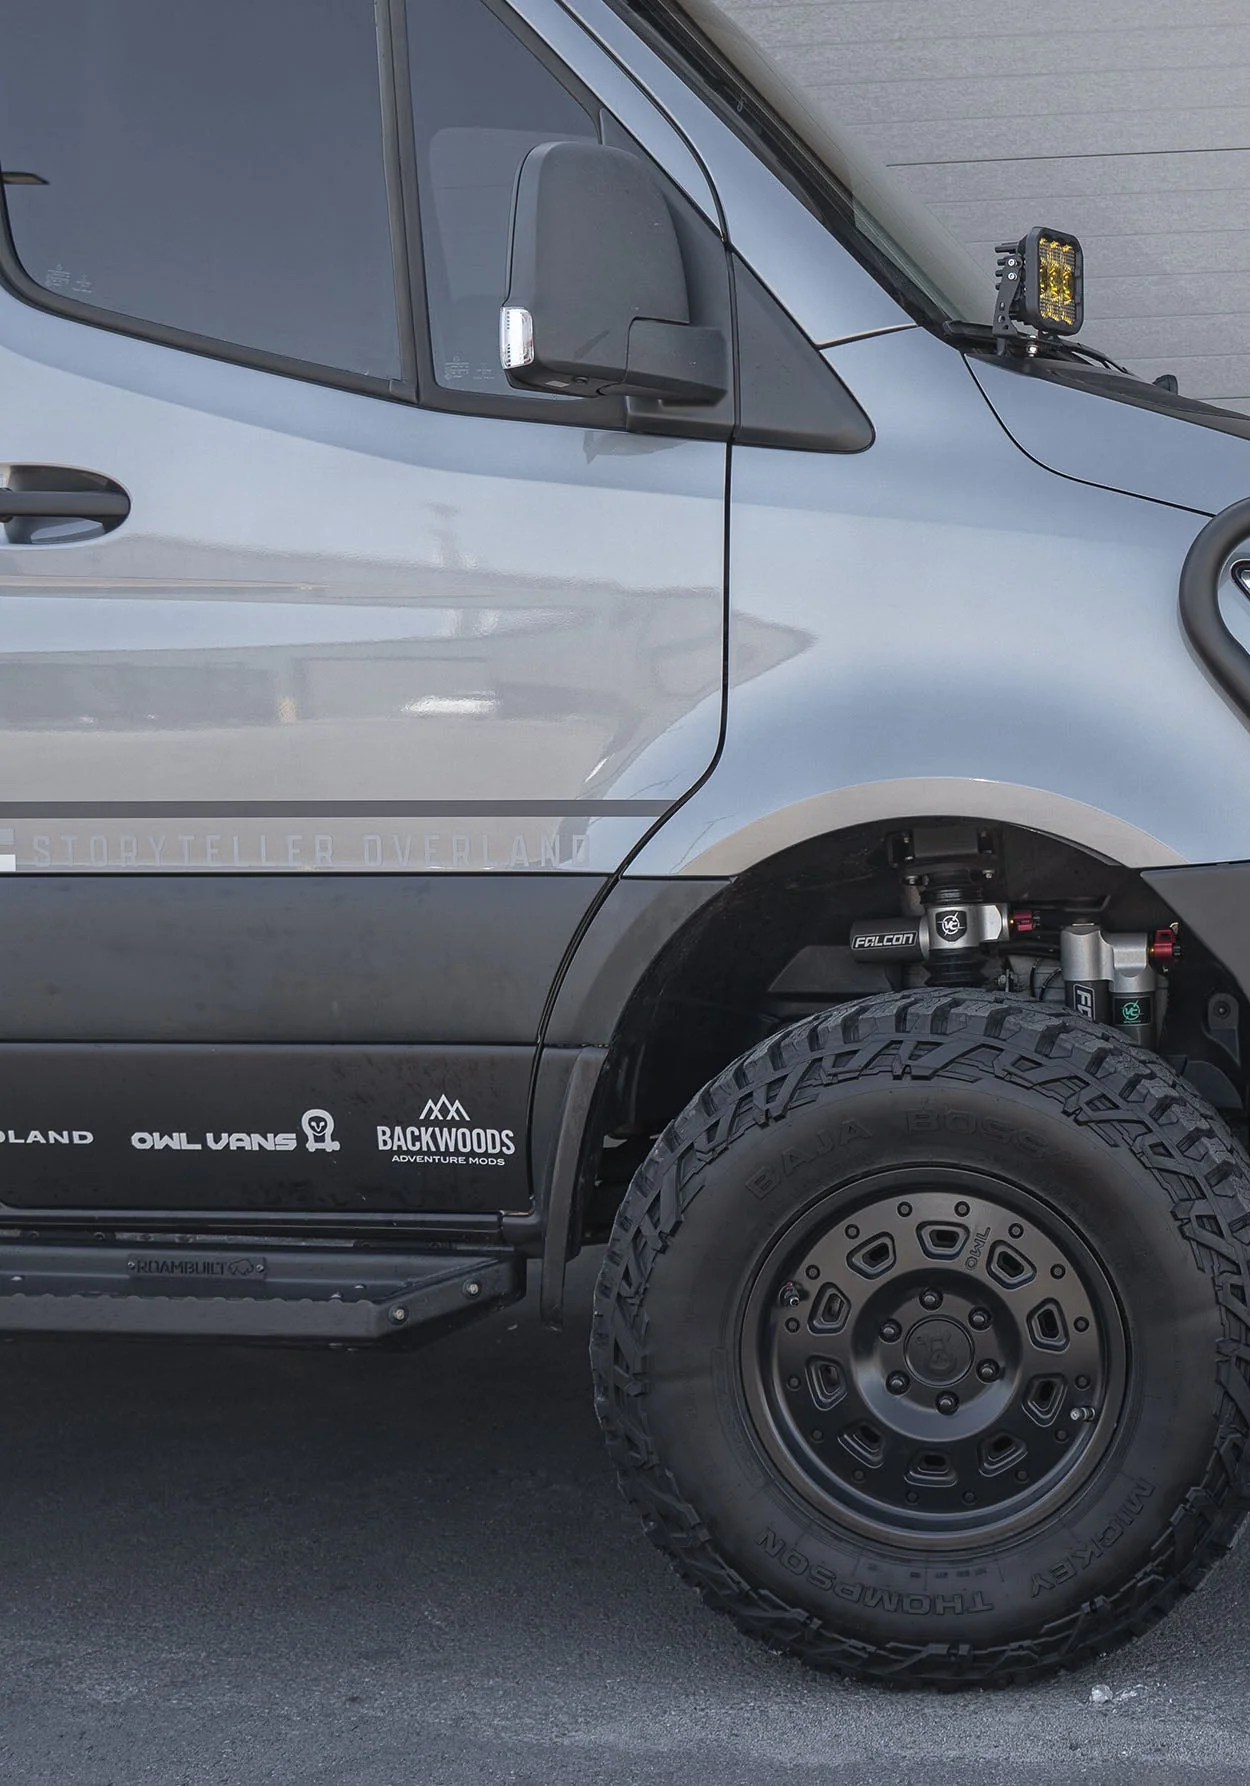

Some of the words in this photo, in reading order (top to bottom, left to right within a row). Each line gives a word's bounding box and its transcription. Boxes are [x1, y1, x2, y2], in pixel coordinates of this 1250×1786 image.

[32, 833, 335, 868] STORYTELLER
[363, 833, 592, 869] OVERLAND
[855, 932, 914, 948] FALCON
[131, 1131, 201, 1150] OWL
[206, 1132, 297, 1151] VANS
[377, 1125, 515, 1155] BACKWOODS
[744, 1115, 875, 1200] BAJA
[904, 1107, 1051, 1161] BOSS
[391, 1155, 467, 1165] ADVENTURE
[469, 1157, 505, 1166] MODS
[965, 1226, 991, 1271] OWL
[136, 1259, 228, 1275] ROAMBUILT
[1029, 1476, 1158, 1598] MICKEY
[755, 1526, 996, 1617] THOMPSON
